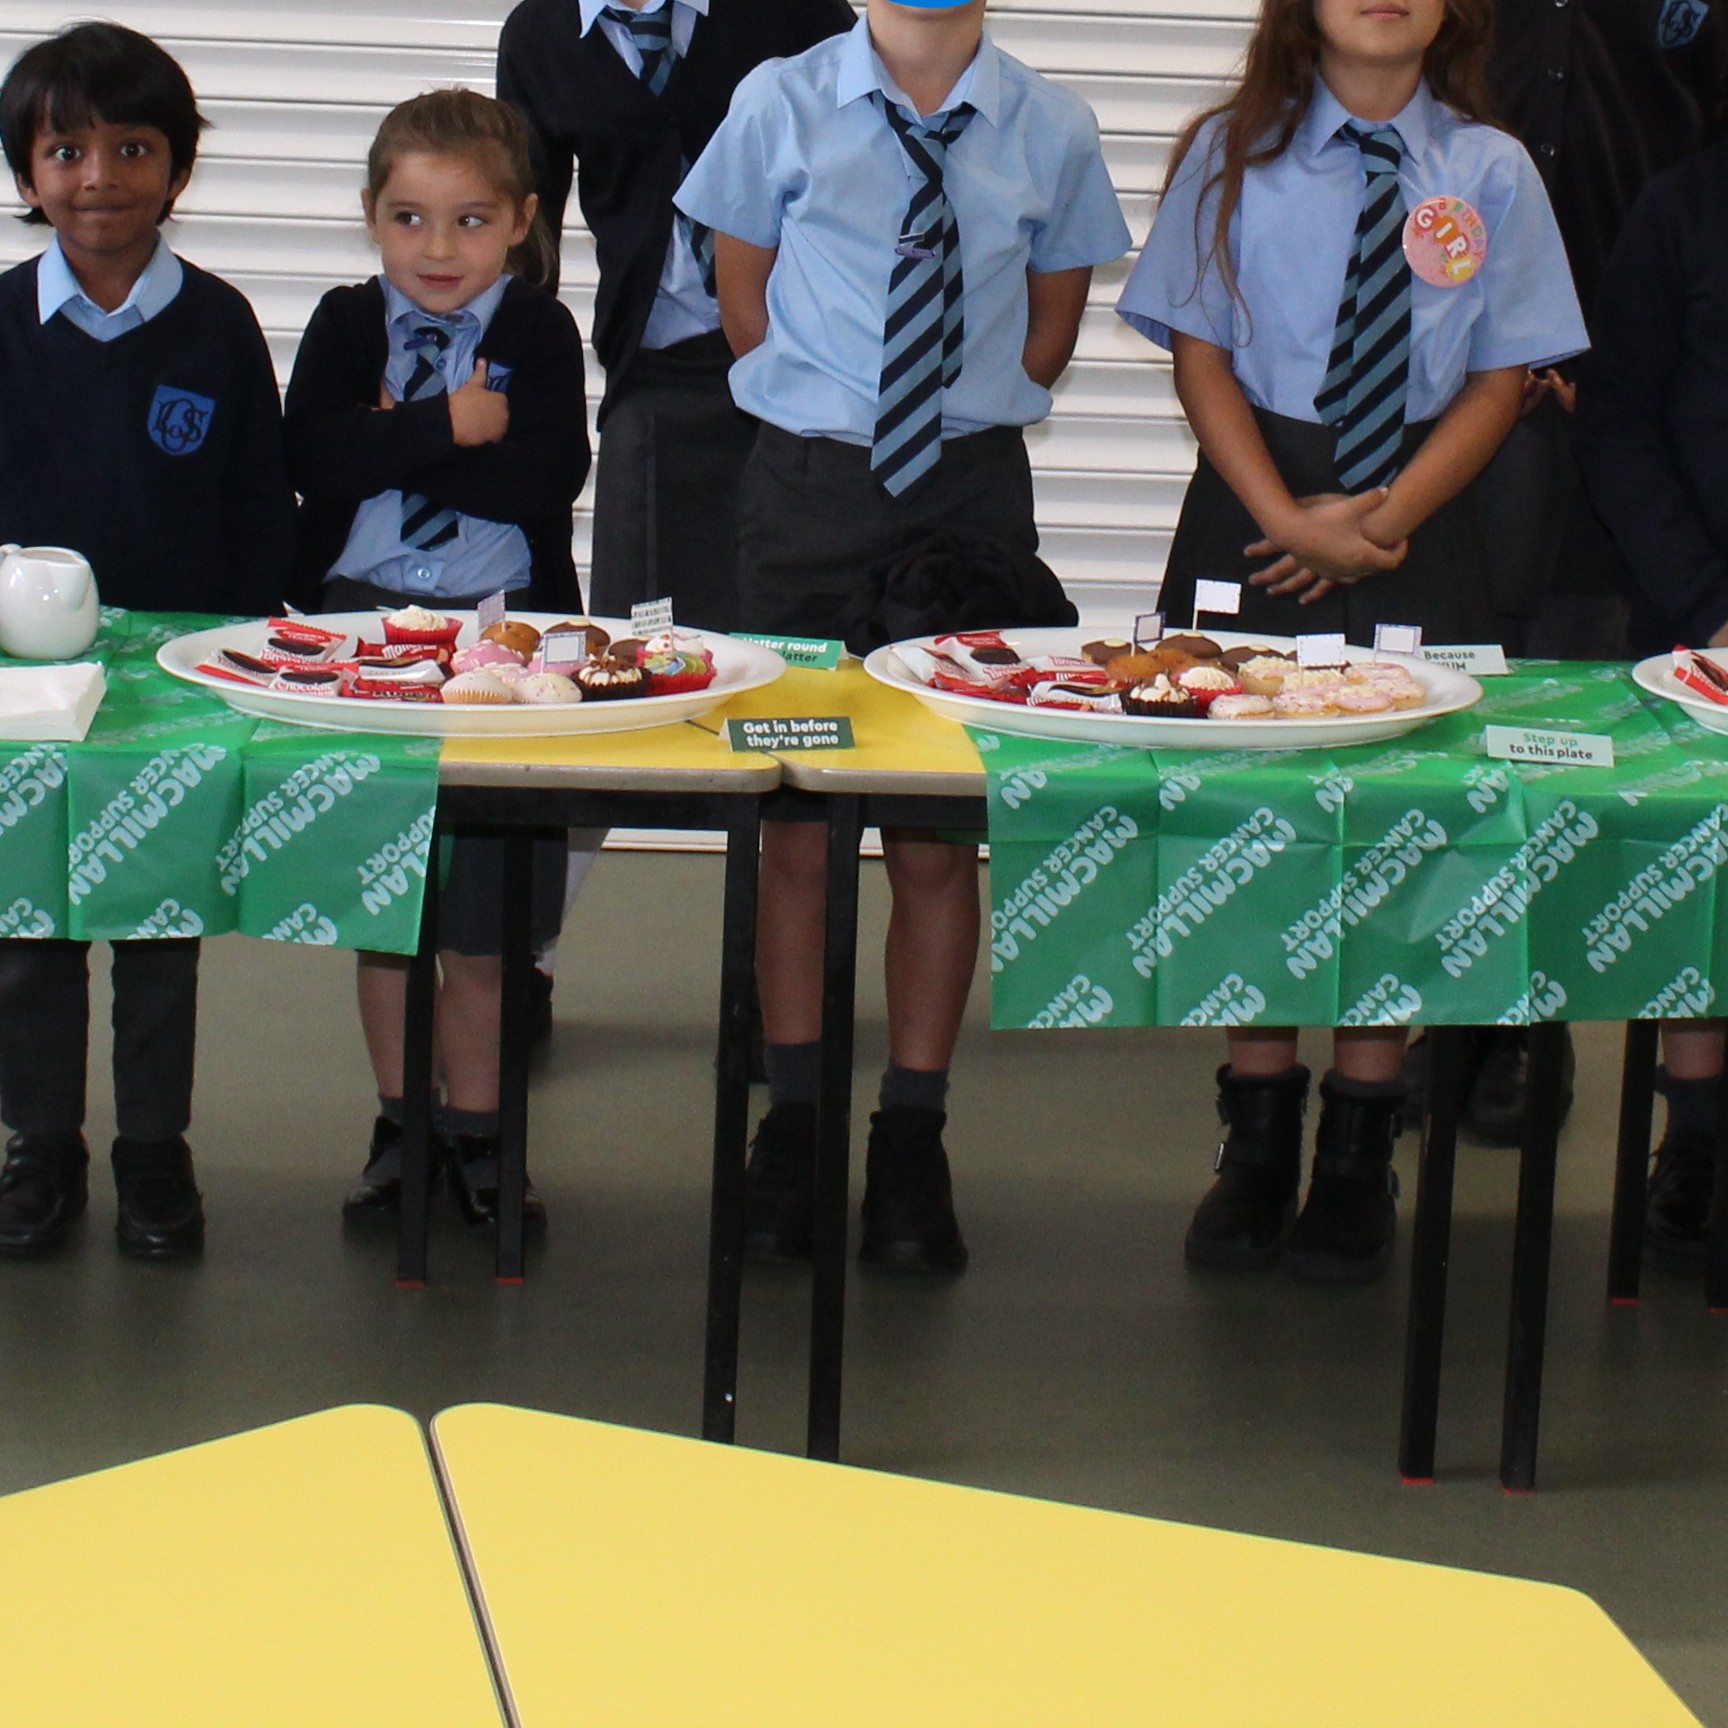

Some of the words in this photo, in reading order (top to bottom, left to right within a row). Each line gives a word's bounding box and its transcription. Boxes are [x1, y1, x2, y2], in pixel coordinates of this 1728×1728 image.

[1415, 206, 1473, 276] GIRL
[787, 641, 828, 653] round
[1423, 651, 1475, 660] Because
[743, 722, 771, 734] Get
[773, 720, 787, 733] in
[790, 719, 838, 732] before
[746, 735, 799, 749] they're
[802, 735, 839, 747] gone
[1509, 744, 1525, 754] to
[1528, 745, 1554, 757] this
[1557, 748, 1592, 760] plate
[1523, 733, 1555, 745] Step
[1560, 737, 1578, 747] up
[69, 745, 226, 905] MACMILLAN
[221, 753, 380, 896] MACMILLAN
[1043, 806, 1117, 873] CANCER
[1198, 807, 1273, 872] CANCER
[1355, 809, 1425, 875] CANCER
[1510, 800, 1576, 871] CANCER
[1125, 867, 1203, 951] SUPPORT
[1132, 818, 1297, 978] MACMILLAN
[1280, 871, 1358, 952] SUPPORT
[1286, 820, 1447, 979] MACMILLAN
[1435, 866, 1516, 951] SUPPORT
[1441, 811, 1599, 978] MACMILLAN
[1582, 864, 1663, 946] SUPPORT
